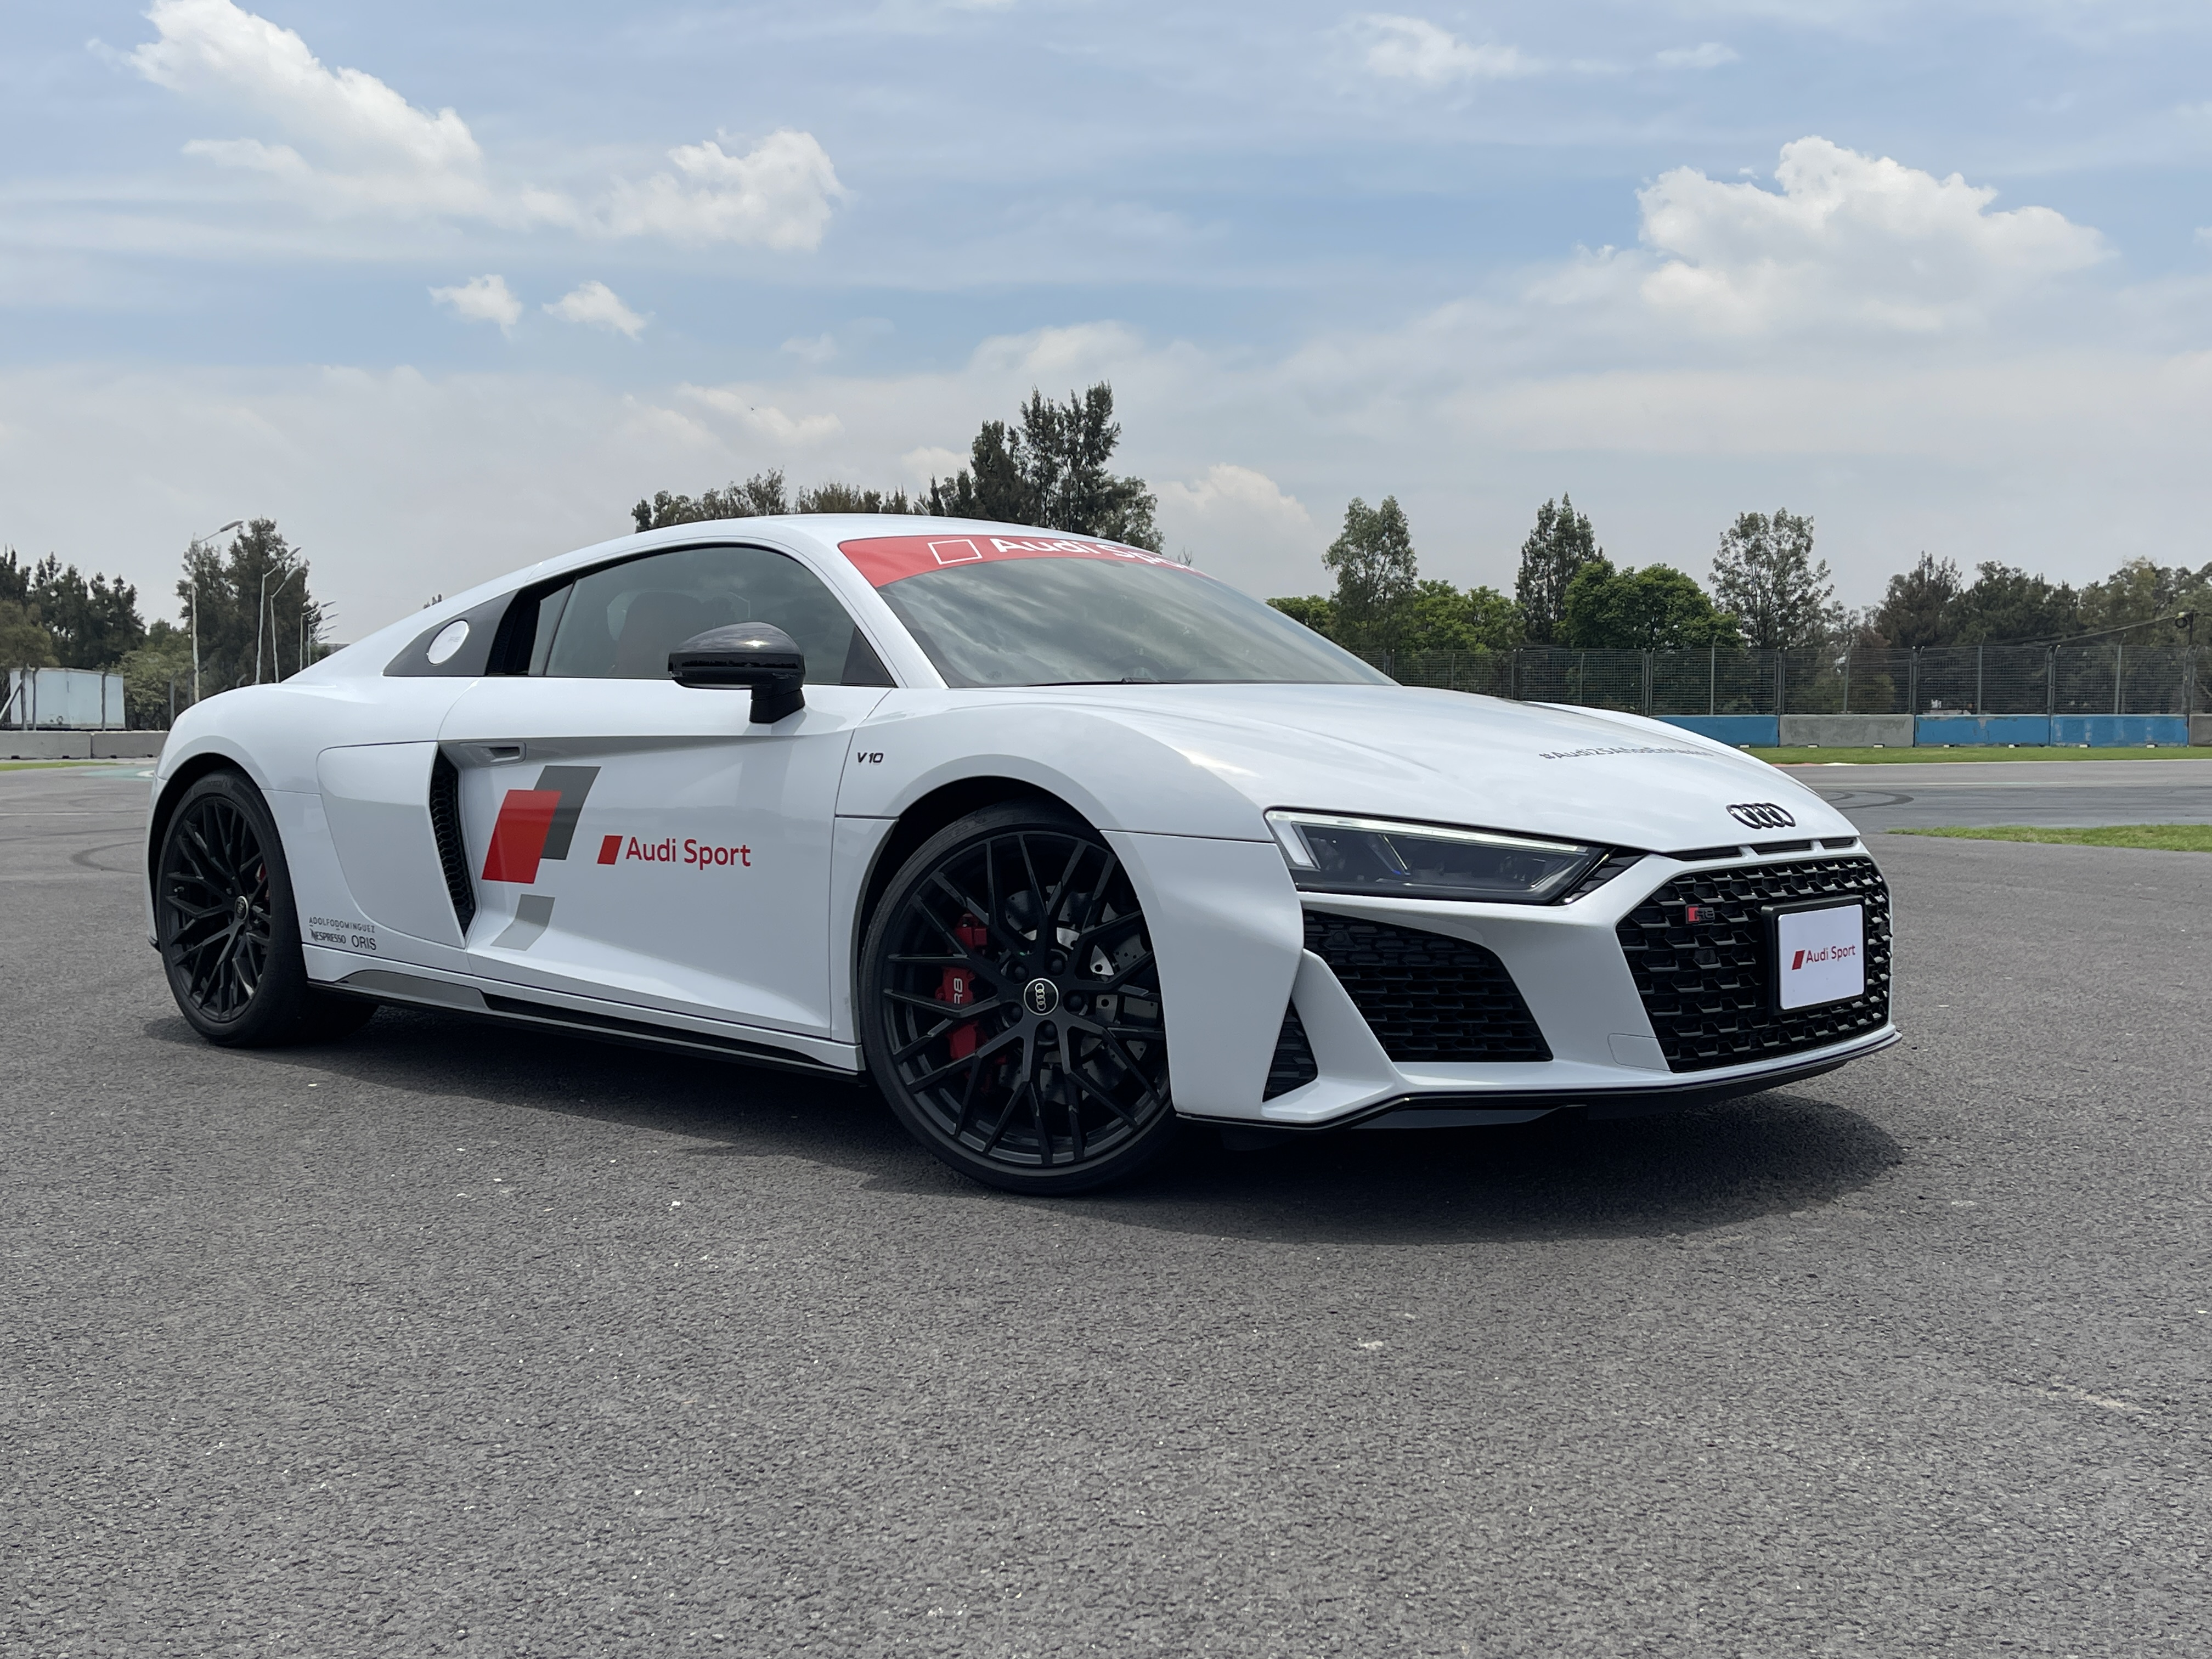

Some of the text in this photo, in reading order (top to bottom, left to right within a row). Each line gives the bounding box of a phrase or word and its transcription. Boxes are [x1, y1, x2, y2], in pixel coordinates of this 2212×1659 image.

[989, 538, 1101, 554] Audi
[625, 837, 751, 870] Audi Sport
[351, 935, 376, 951] ORIS
[1805, 944, 1855, 963] Audi Sport
